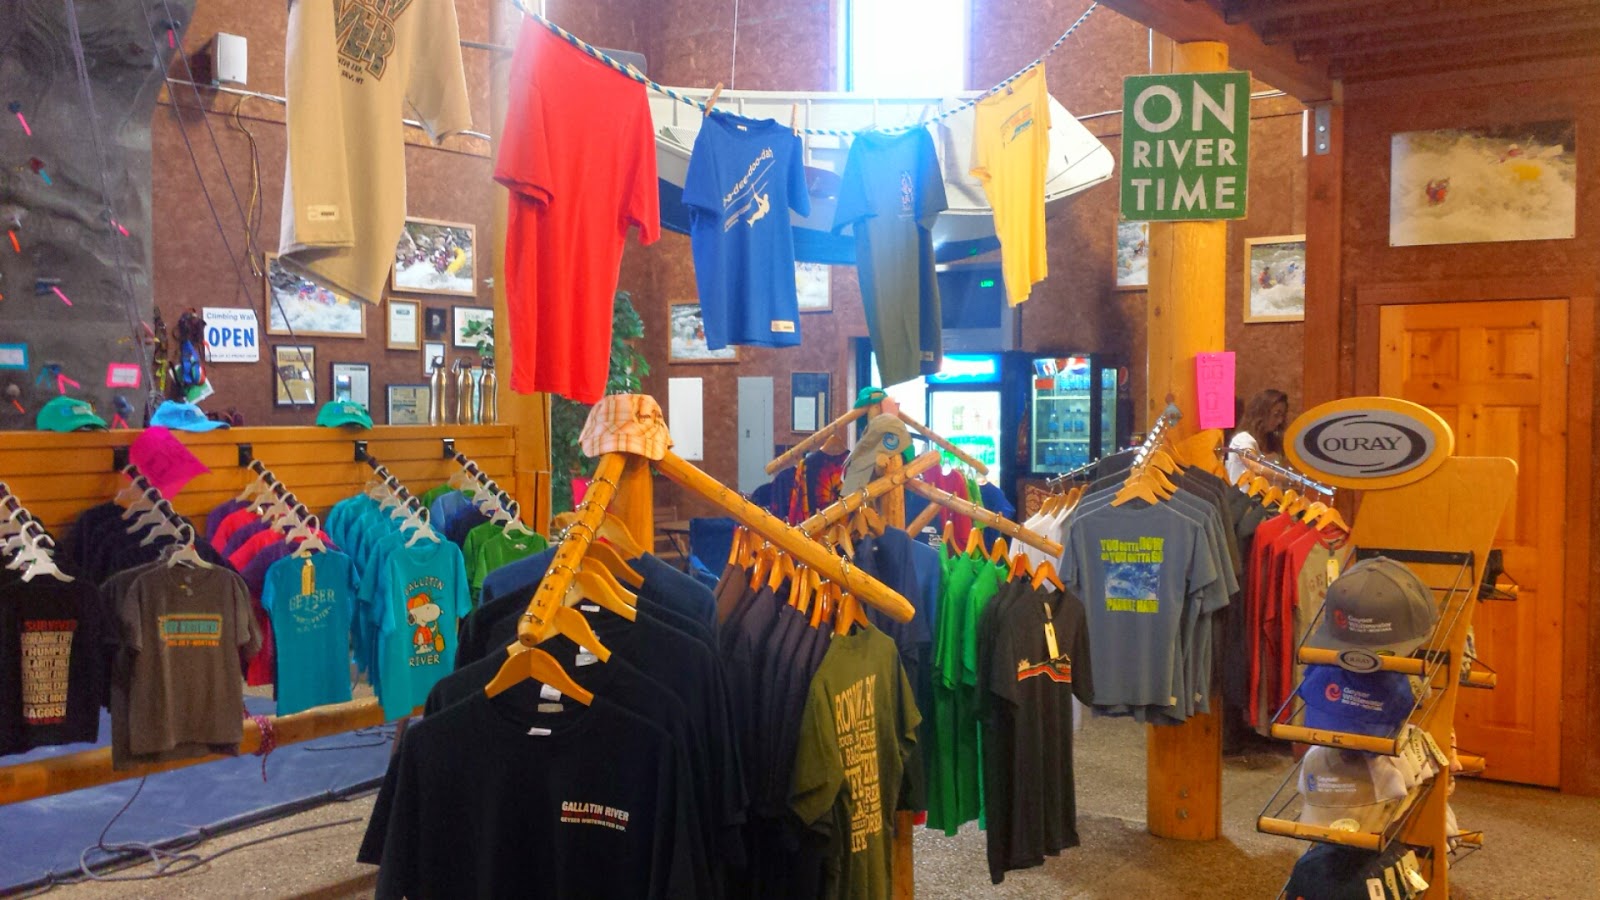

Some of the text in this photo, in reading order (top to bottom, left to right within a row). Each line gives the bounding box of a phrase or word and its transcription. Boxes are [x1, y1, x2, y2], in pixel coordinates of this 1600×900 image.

[1133, 80, 1236, 134] ON
[1133, 138, 1238, 170] RIVER
[1131, 174, 1236, 212] TIME
[206, 312, 255, 322] Climbing Wall
[208, 326, 255, 347] OPEN
[1323, 436, 1402, 452] OURAY
[408, 654, 441, 667] RIVER
[561, 801, 630, 822] GALLATIN RIVER
